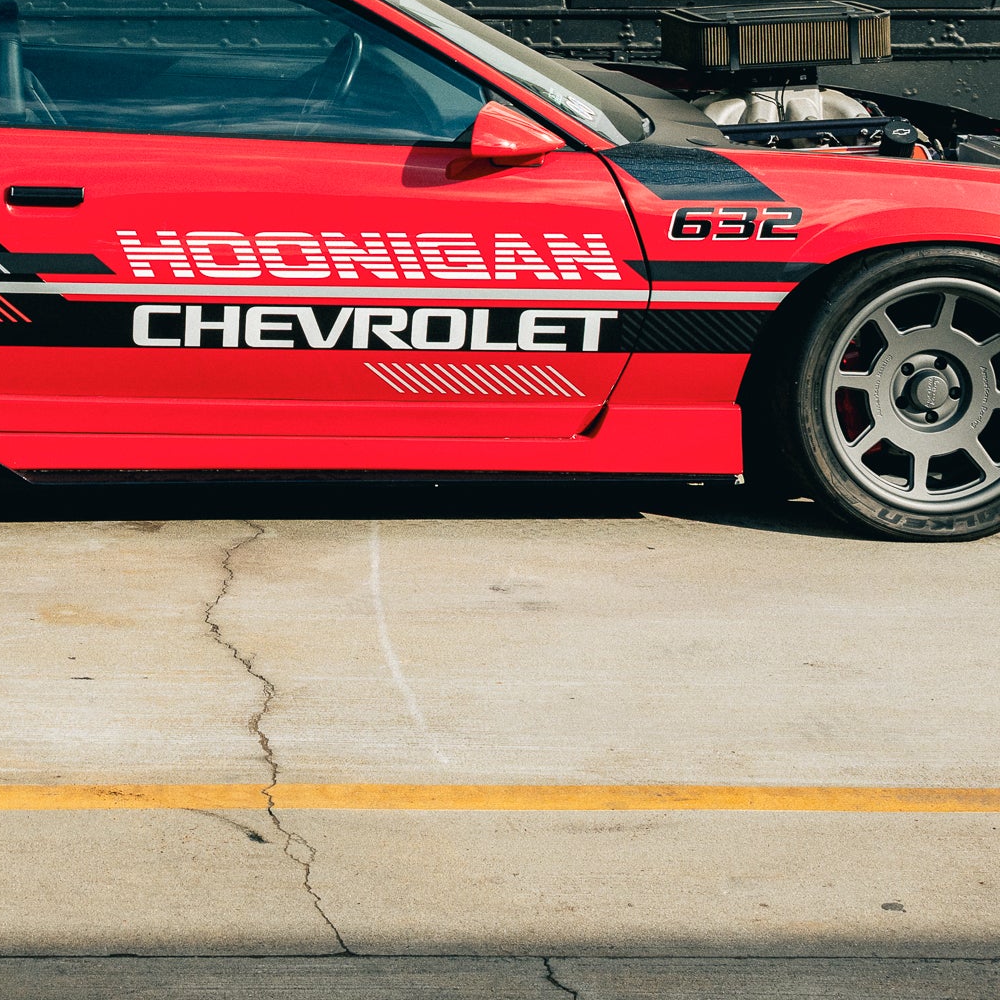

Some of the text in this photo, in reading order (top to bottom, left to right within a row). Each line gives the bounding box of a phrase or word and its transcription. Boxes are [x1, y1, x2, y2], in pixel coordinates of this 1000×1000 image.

[668, 207, 803, 241] 632
[116, 230, 622, 282] HOONIGAN
[132, 304, 619, 353] CHEVROLET
